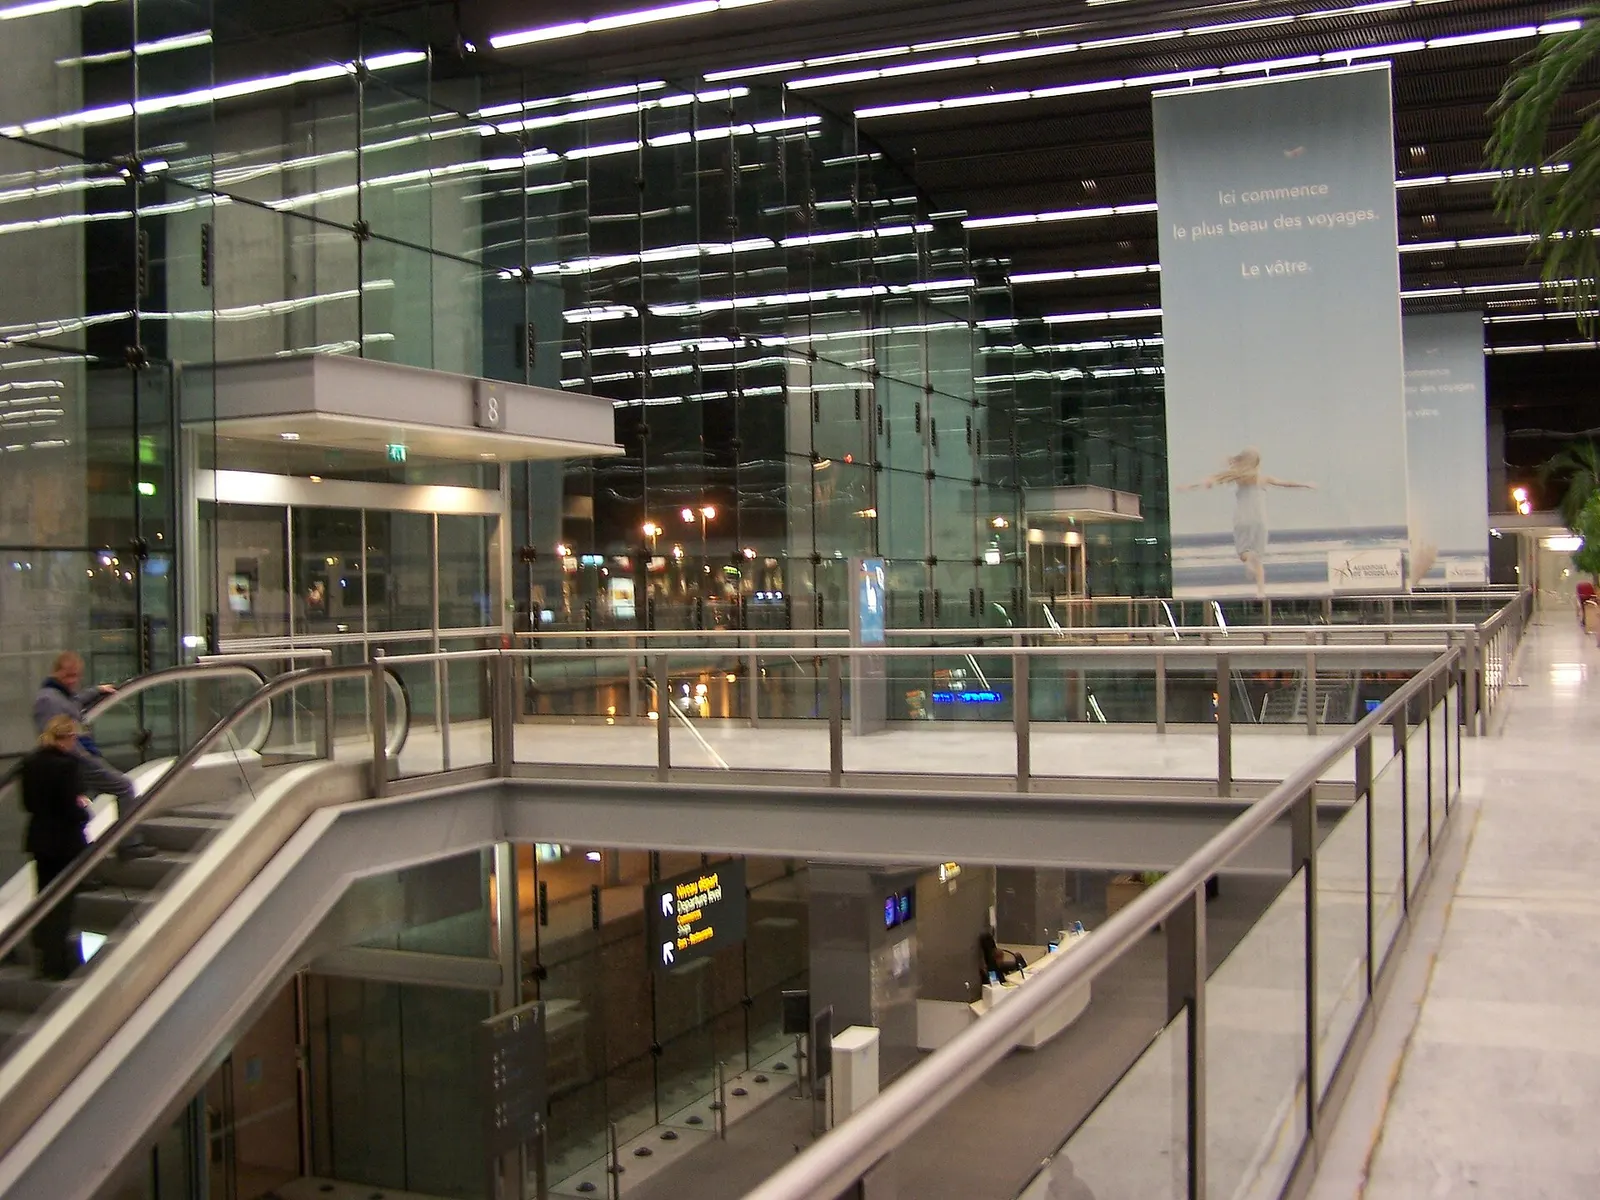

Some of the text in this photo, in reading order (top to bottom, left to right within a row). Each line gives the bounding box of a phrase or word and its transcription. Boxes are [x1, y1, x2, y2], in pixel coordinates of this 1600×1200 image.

[1218, 181, 1329, 206] Ici commence
[1172, 207, 1380, 242] le plus beau des voyages.
[1241, 258, 1312, 278] Le vôtre.
[487, 396, 499, 423] 8
[677, 894, 708, 914] Departure
